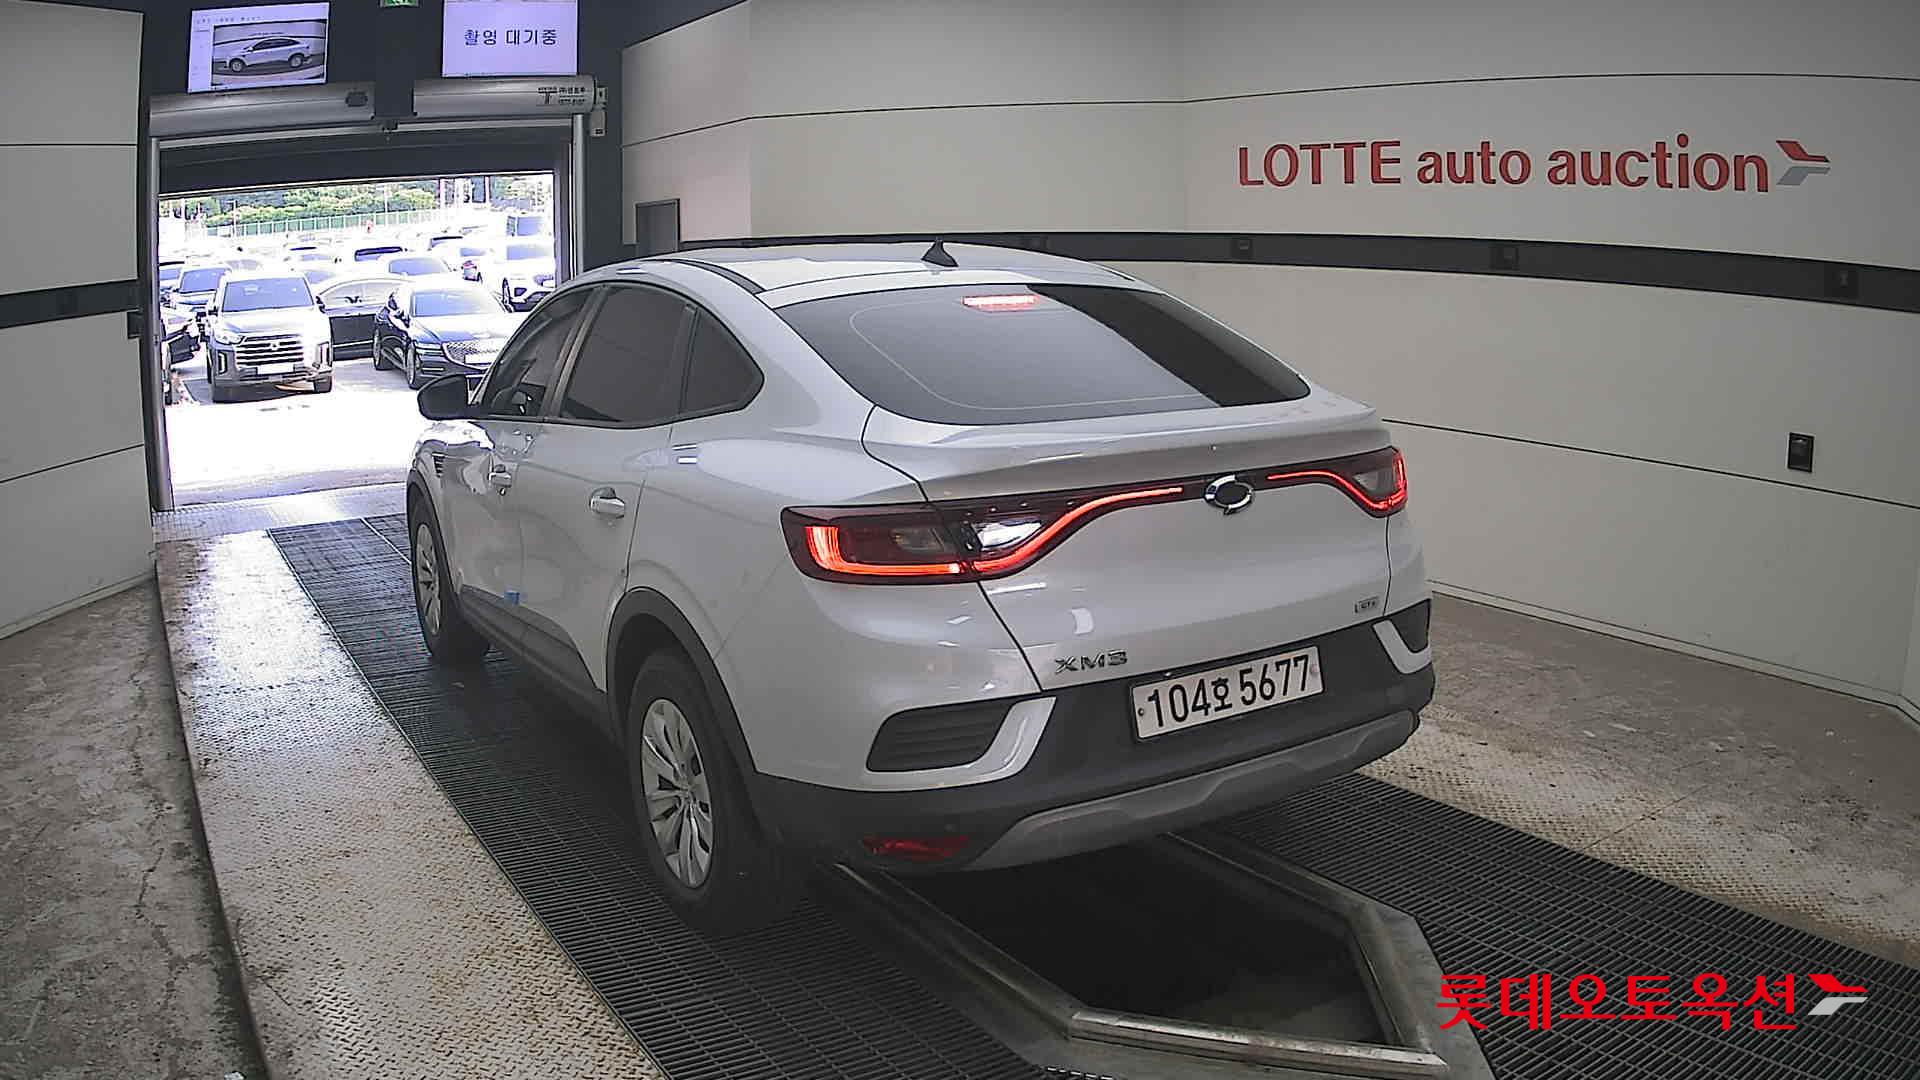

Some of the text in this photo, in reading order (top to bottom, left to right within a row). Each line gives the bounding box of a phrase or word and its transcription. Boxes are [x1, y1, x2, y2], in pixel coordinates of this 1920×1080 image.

[505, 28, 557, 46] 대기중
[1239, 133, 1769, 193] LOTTE auto auction
[1055, 650, 1128, 674] XM3
